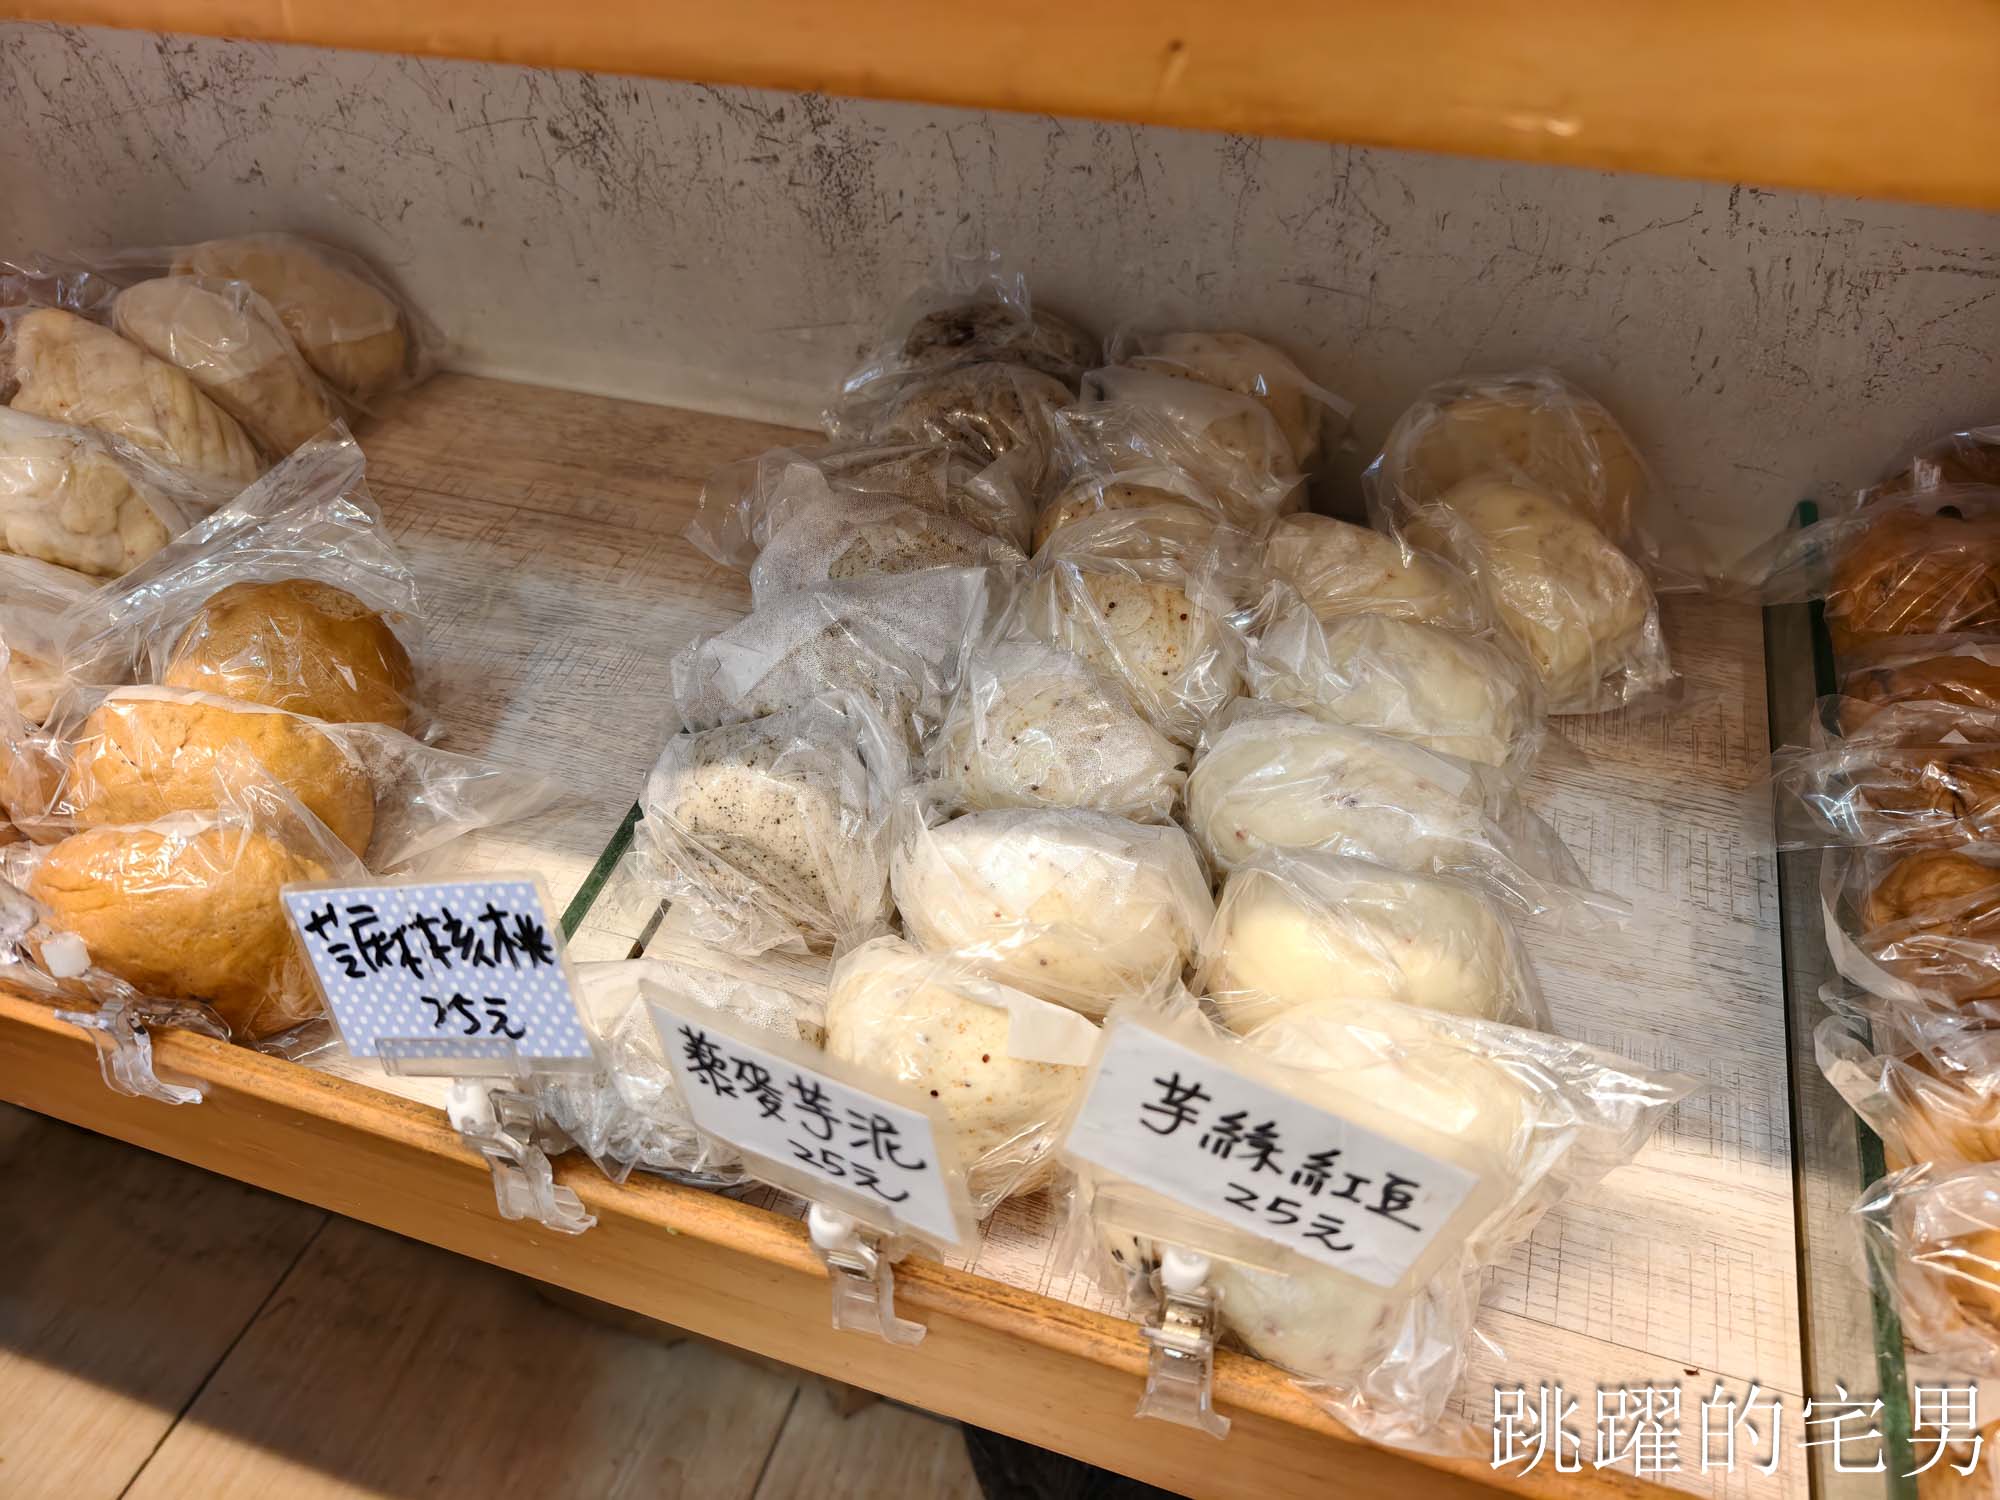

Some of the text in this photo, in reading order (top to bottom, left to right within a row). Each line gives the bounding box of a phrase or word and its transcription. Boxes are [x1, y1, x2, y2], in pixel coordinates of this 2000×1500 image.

[420, 993, 526, 1039] 25元
[788, 1139, 909, 1202] 25元
[1225, 1182, 1353, 1251] 25元
